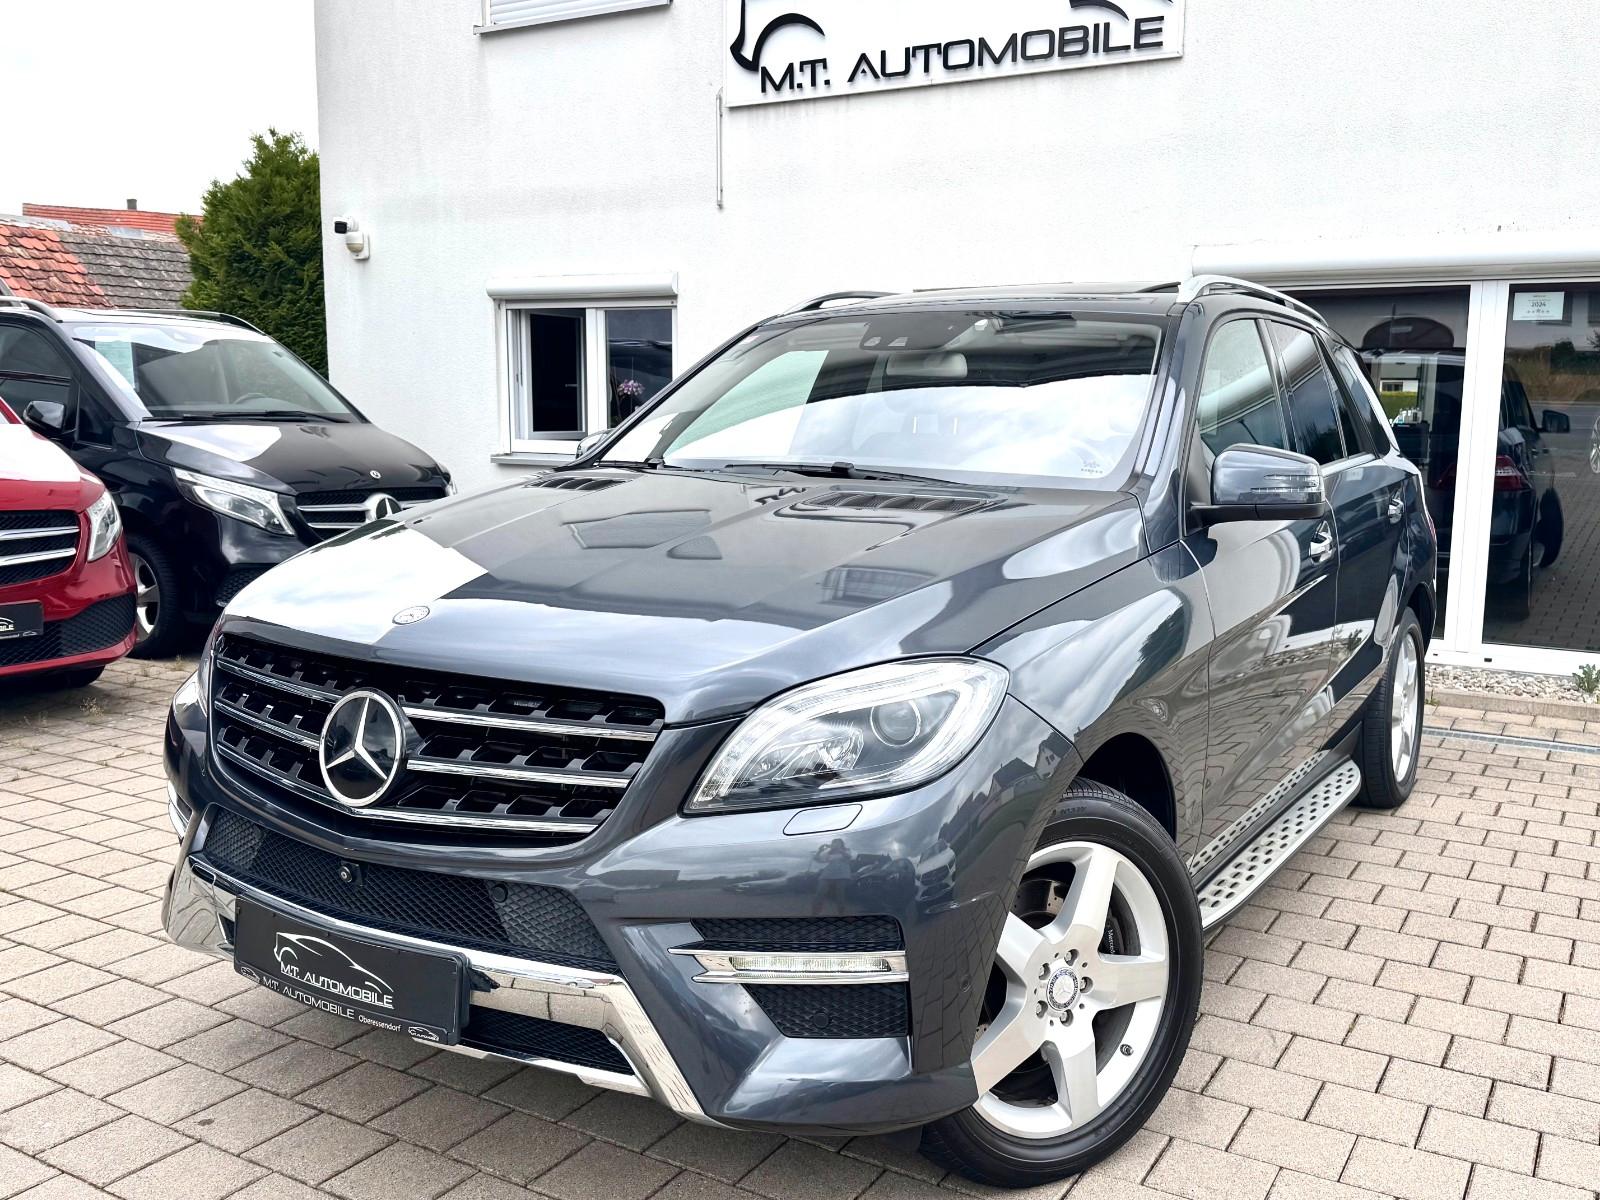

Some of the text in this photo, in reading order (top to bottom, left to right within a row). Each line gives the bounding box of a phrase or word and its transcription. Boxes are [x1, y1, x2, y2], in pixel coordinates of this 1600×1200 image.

[760, 15, 1165, 93] M.T. AUTOMOBILE
[262, 976, 280, 992] M.T.
[282, 986, 355, 1019] AUTOMOBILE
[358, 1014, 402, 1032] Oberessendorf
[280, 960, 394, 1008] M.T. AUTOMOBILE
